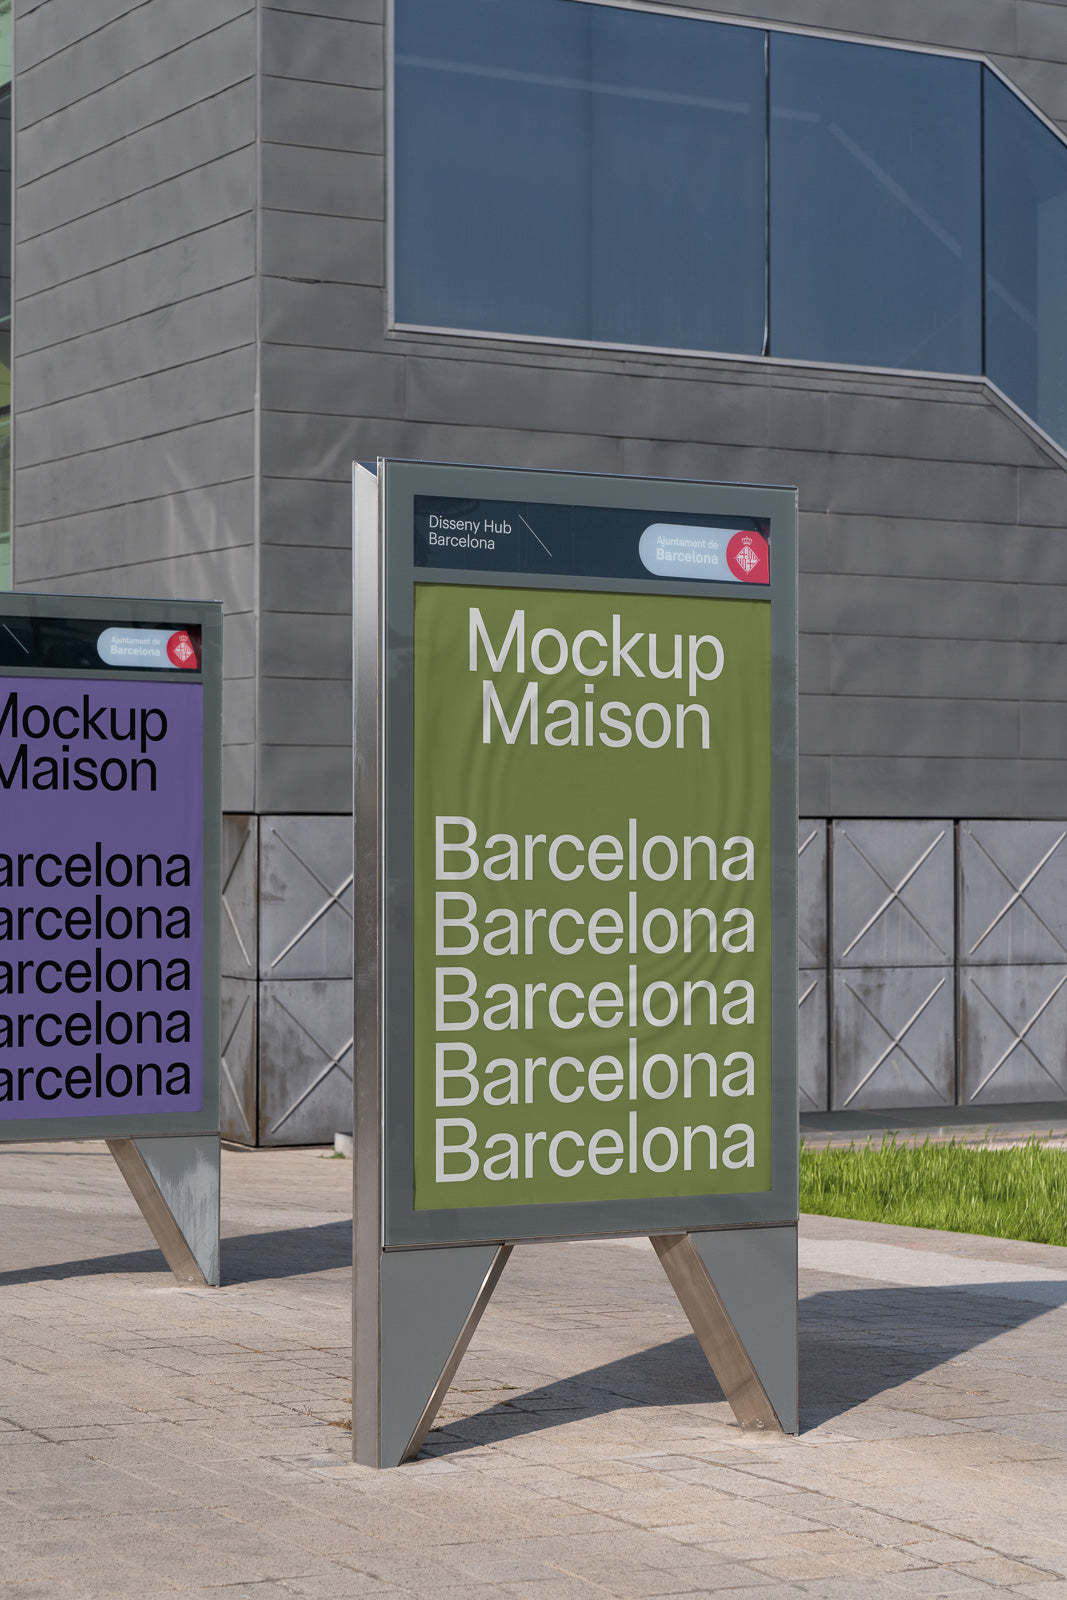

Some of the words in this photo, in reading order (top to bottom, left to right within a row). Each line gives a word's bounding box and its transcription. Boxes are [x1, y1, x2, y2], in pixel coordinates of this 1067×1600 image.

[429, 515, 480, 534] Disseny
[484, 519, 512, 534] Hub
[429, 532, 495, 550] Barcelona
[656, 535, 706, 548] Ajuntament
[707, 538, 719, 550] de
[656, 547, 719, 565] Barcelona
[111, 645, 161, 657] Barcelona
[469, 608, 724, 697] Mockup
[483, 680, 709, 749] Maison
[0, 744, 156, 791] Maison
[436, 816, 754, 882] Barcelona
[436, 891, 754, 956] Barcelona
[436, 965, 754, 1031] Barcelona
[436, 1038, 754, 1107] Barcelona
[436, 1111, 754, 1182] Barcelona
